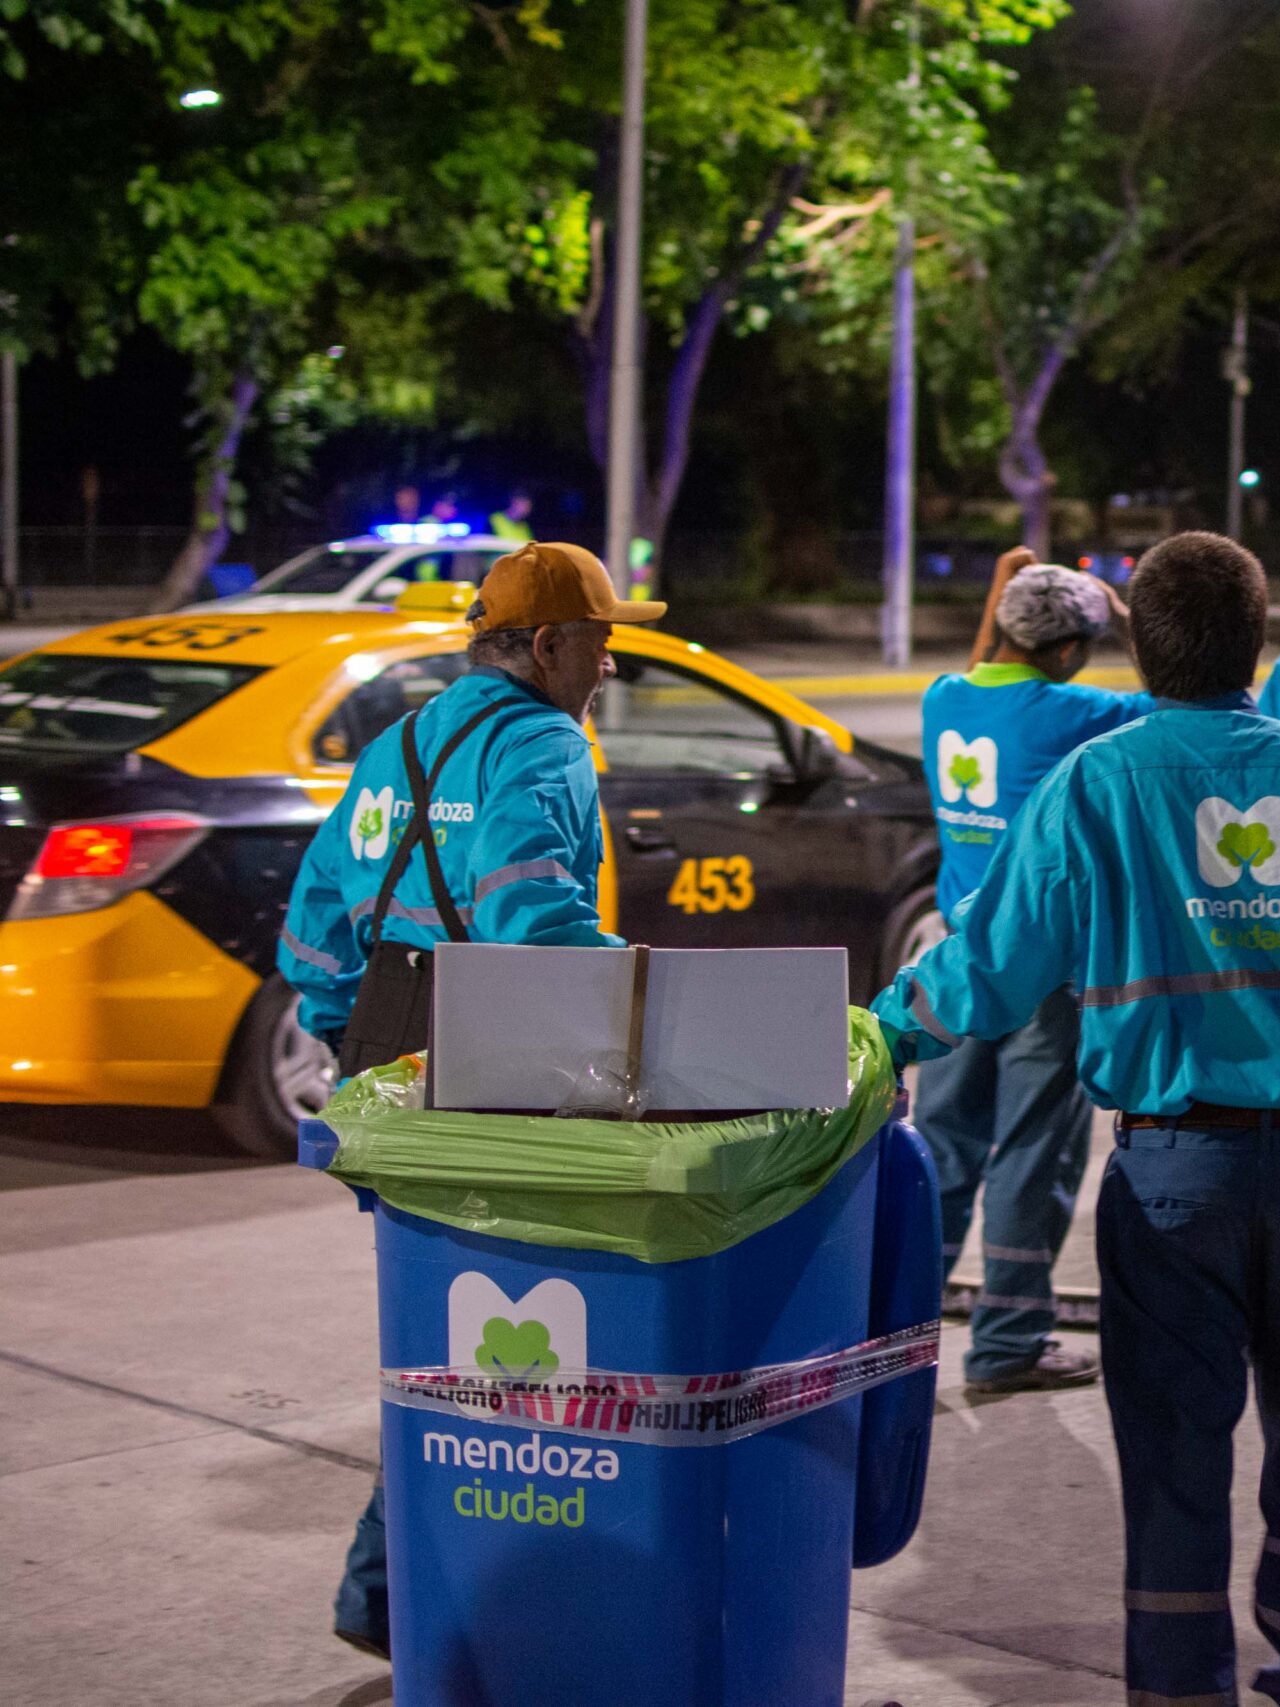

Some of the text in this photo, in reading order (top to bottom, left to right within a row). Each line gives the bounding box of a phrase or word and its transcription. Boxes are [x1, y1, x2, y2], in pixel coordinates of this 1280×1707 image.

[106, 622, 266, 650] 453
[393, 796, 474, 822] mdoza
[667, 854, 755, 914] 453
[423, 1432, 620, 1480] mendoza
[453, 1477, 585, 1528] ciudad
